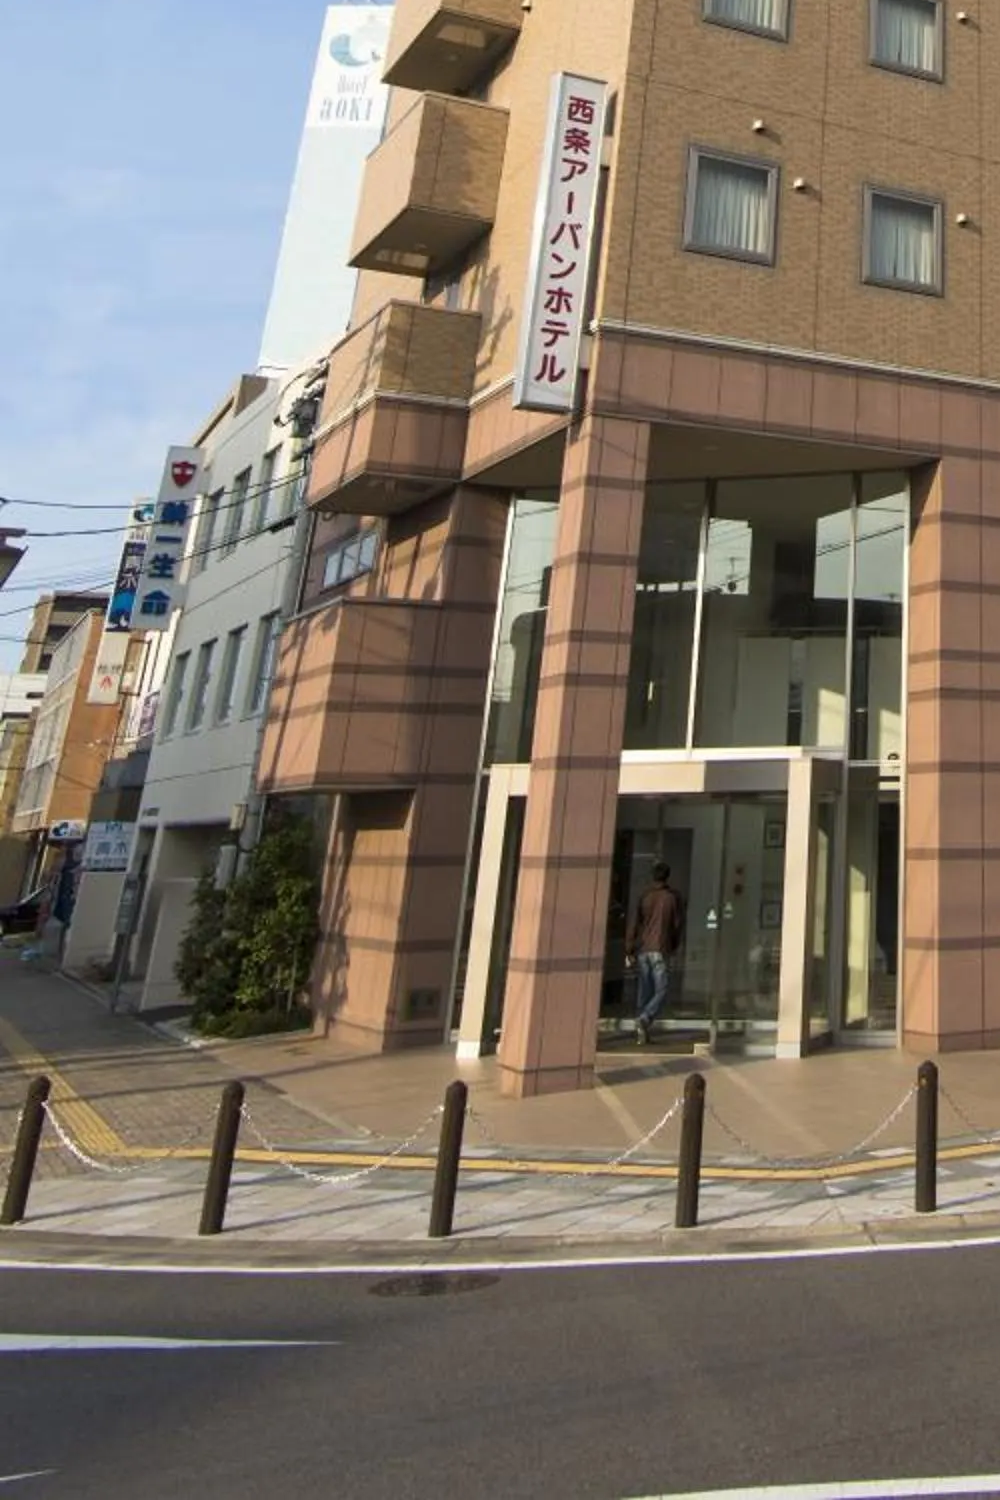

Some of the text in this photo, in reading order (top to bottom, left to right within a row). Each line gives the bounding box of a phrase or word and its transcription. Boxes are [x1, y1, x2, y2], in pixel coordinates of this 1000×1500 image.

[534, 95, 597, 384] 西条アーバンホテル
